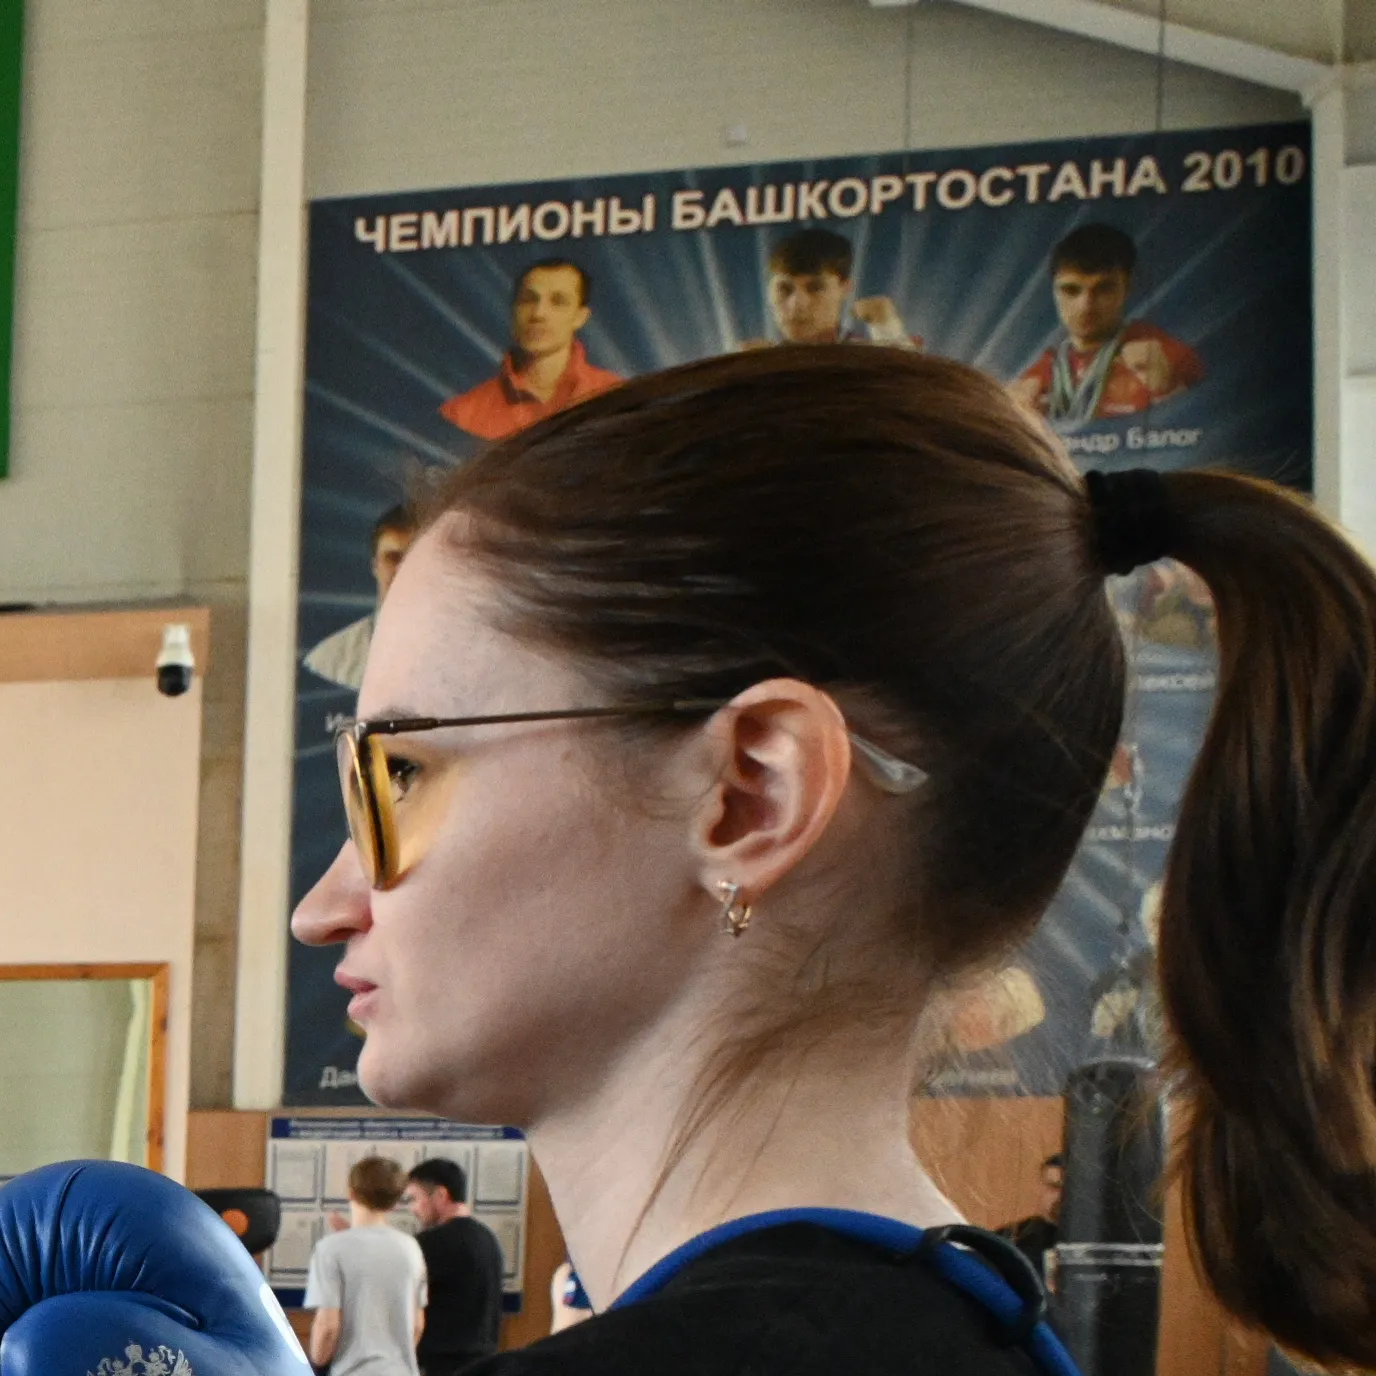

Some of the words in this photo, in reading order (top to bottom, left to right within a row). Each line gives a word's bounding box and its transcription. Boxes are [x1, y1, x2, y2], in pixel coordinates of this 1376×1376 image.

[354, 194, 656, 254] ЧЕМПИОНЫ
[672, 155, 1166, 232] БАШКОРТОСТАНА
[1182, 146, 1307, 193] 2010
